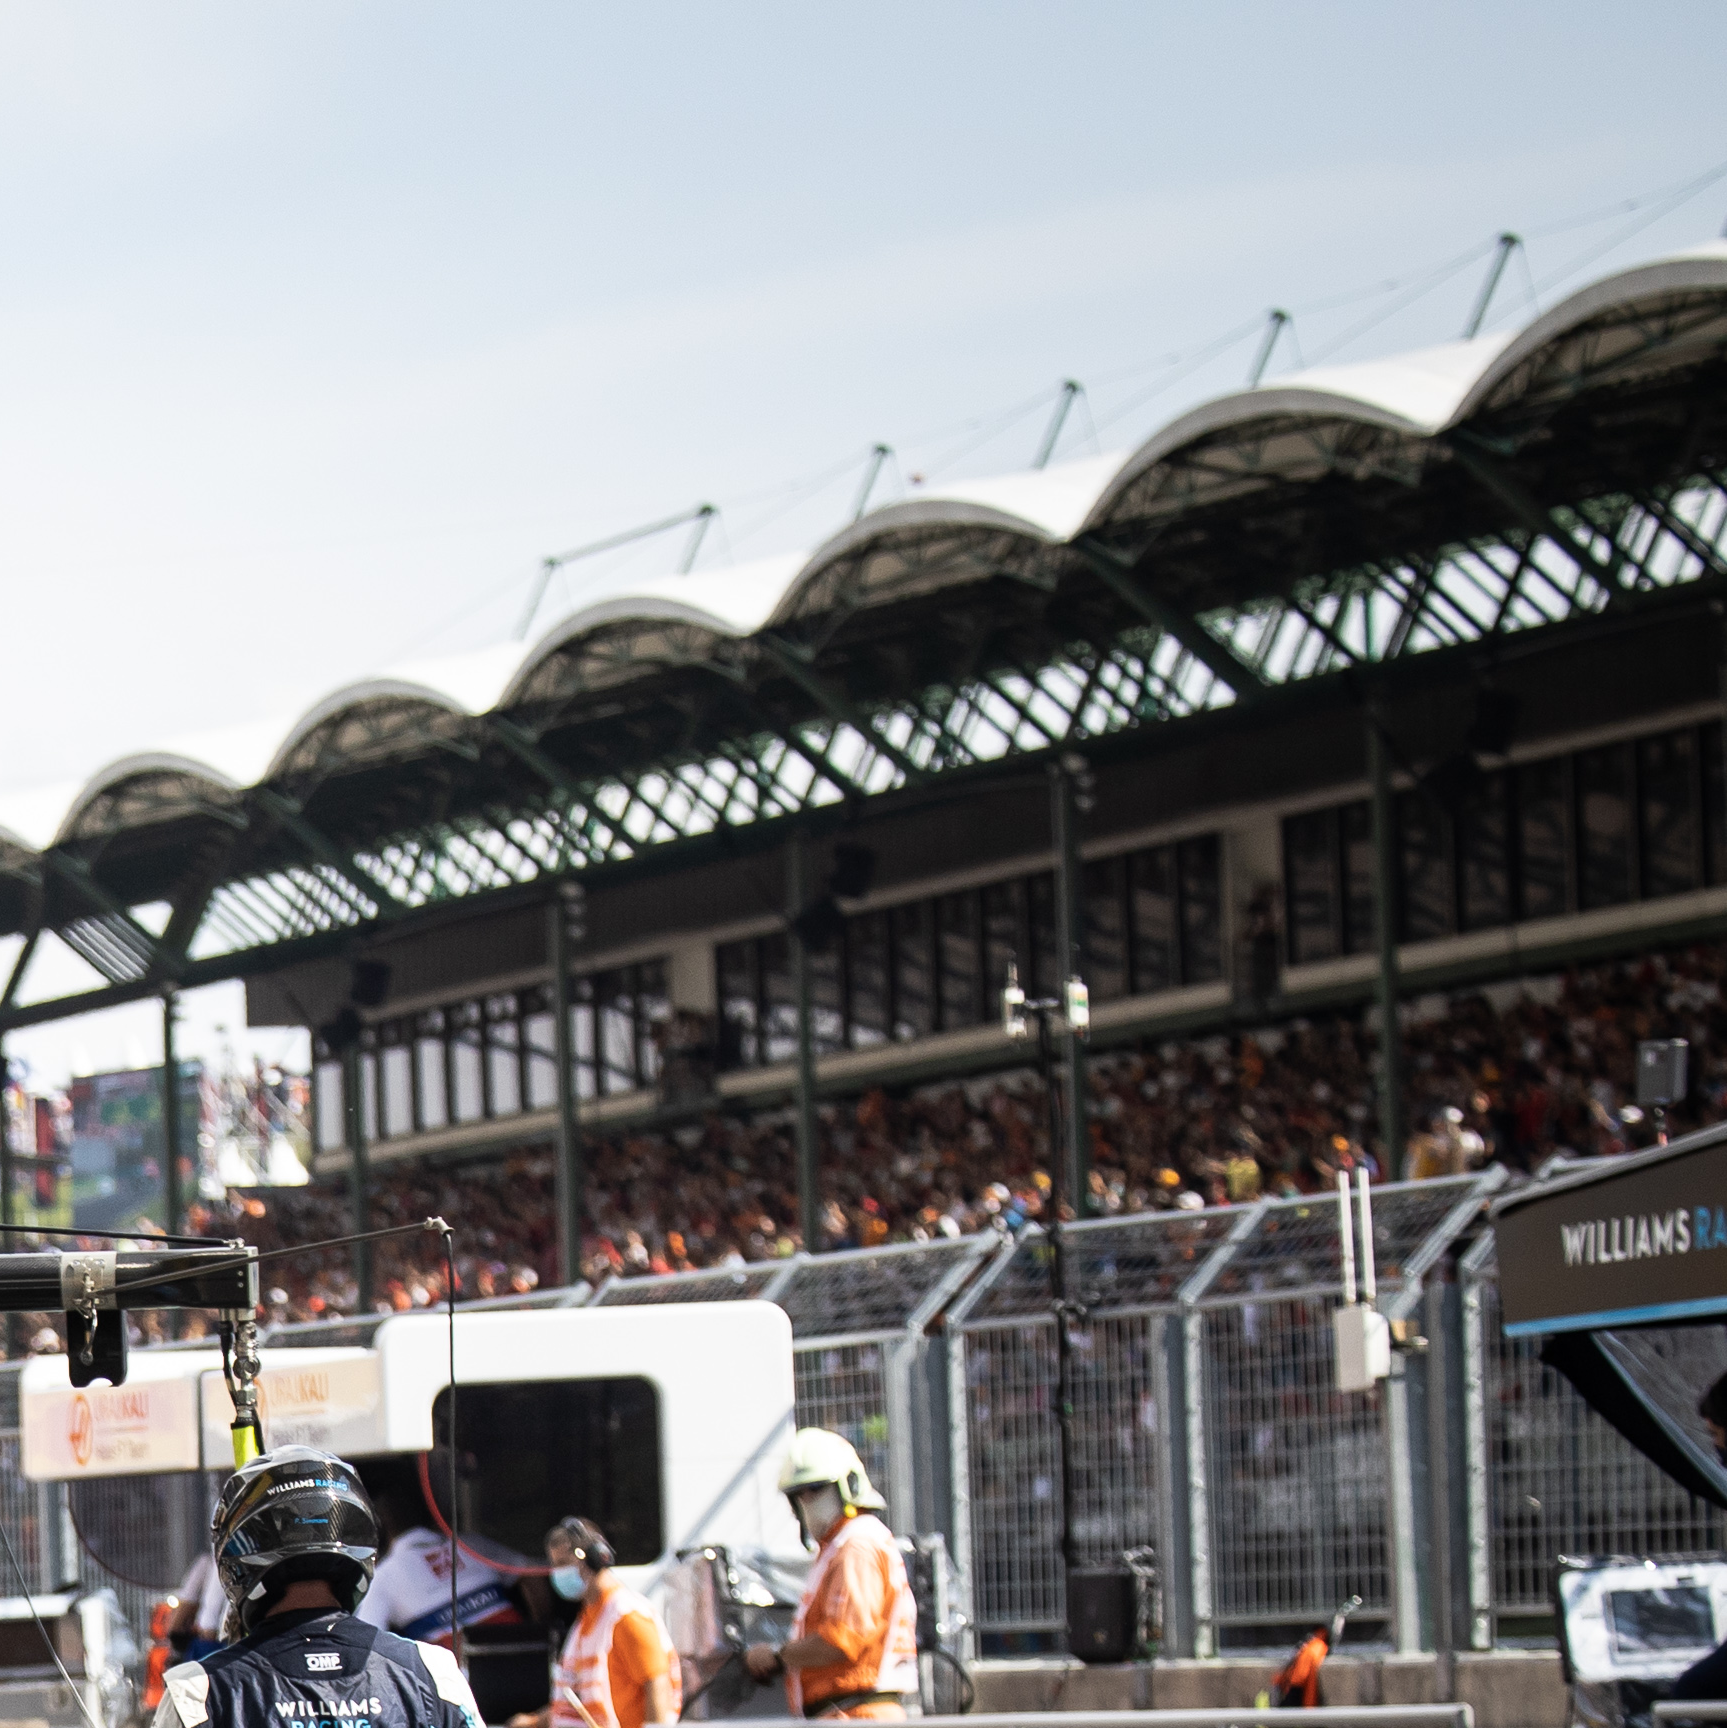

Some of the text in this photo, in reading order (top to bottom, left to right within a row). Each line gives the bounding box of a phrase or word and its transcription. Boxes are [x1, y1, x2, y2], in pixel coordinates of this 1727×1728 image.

[1560, 1207, 1692, 1268] WILLIAMS
[267, 1479, 348, 1496] WILLIAMS RACING
[305, 1655, 341, 1669] OMP
[275, 1697, 383, 1717] WILLIAMS
